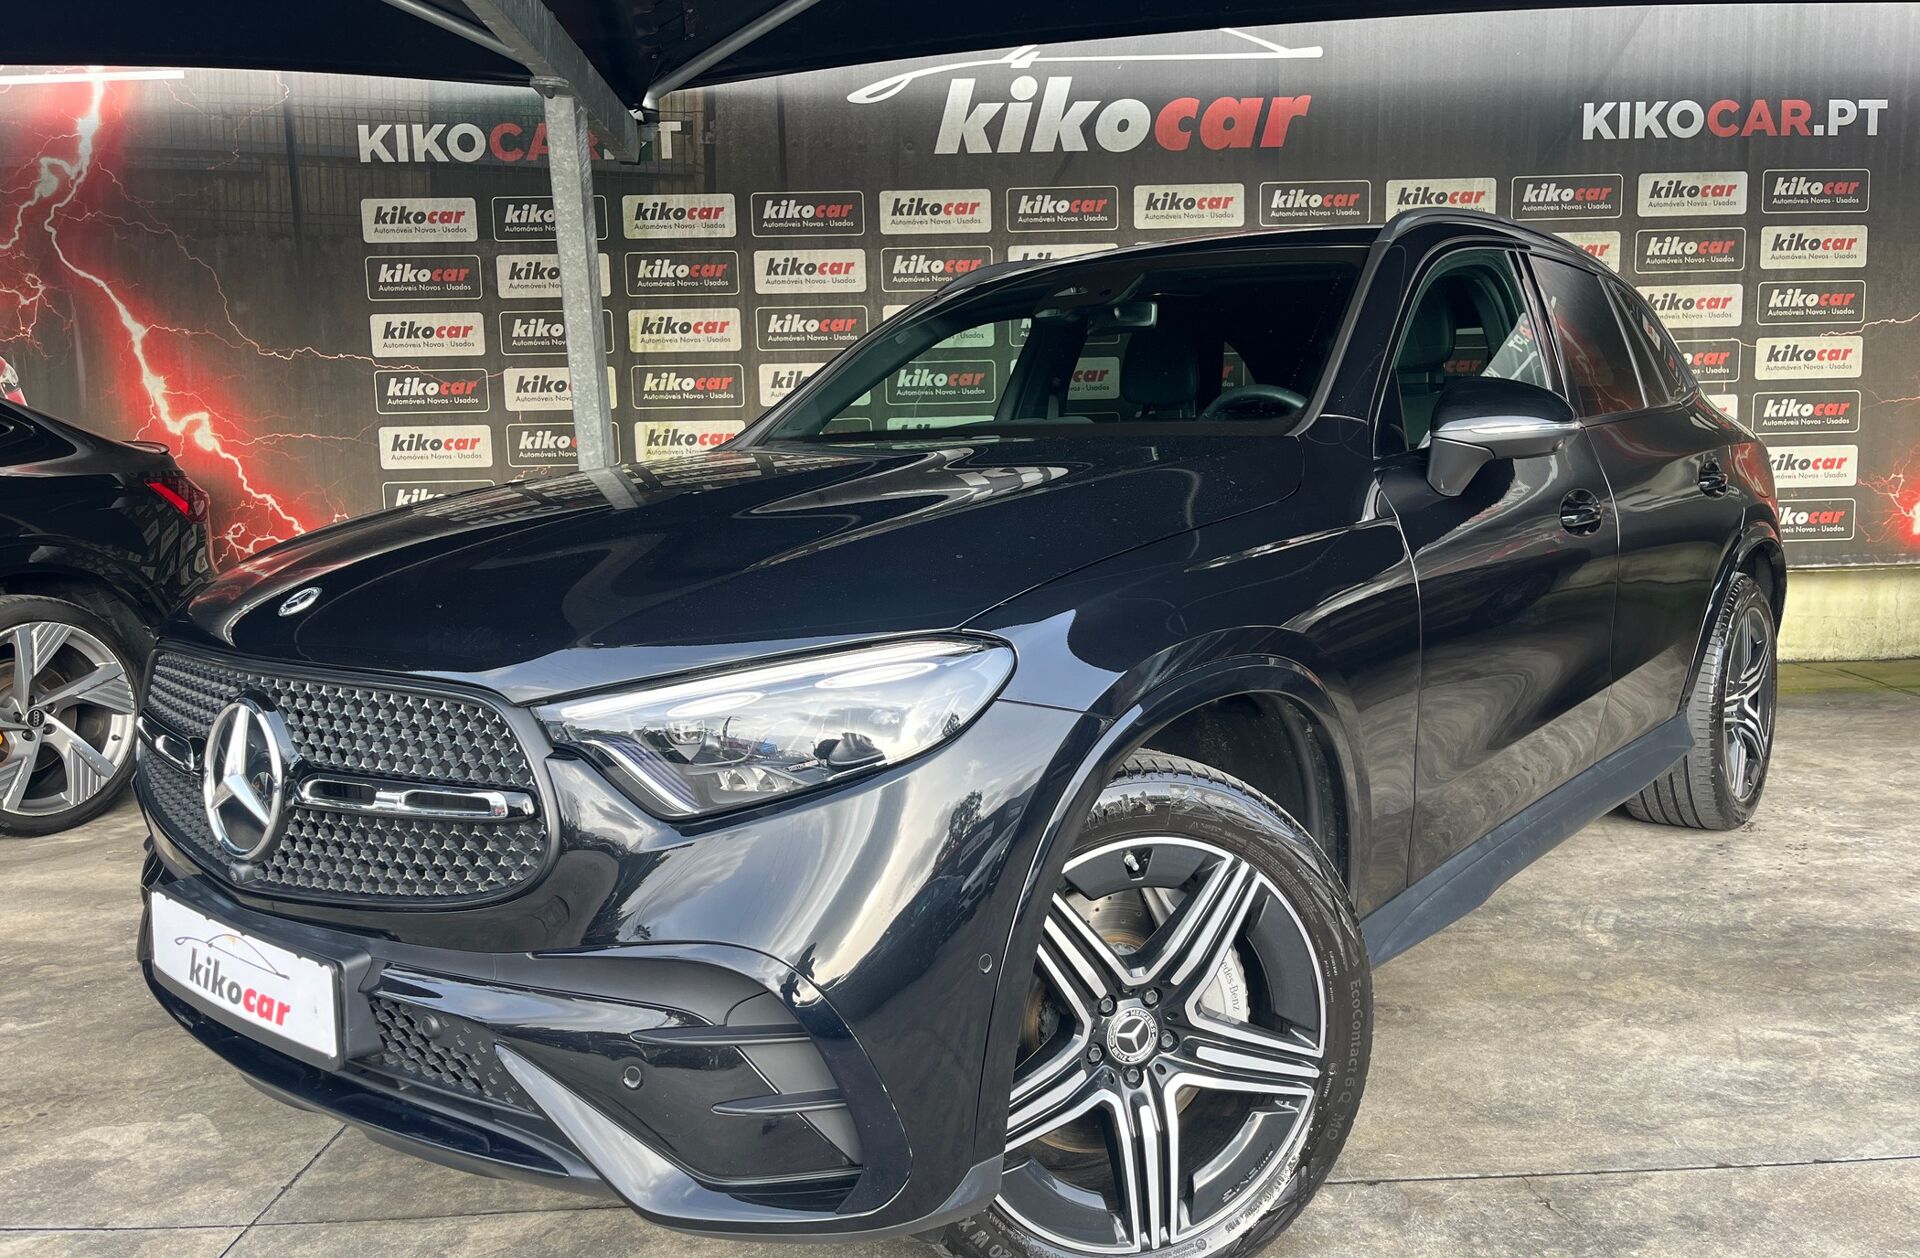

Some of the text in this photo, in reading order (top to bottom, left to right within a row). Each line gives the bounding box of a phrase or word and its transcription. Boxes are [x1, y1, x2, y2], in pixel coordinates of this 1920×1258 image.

[934, 75, 1311, 155] kikocar
[1583, 99, 1888, 140] KIKOCAR.PT
[1522, 183, 1611, 202] kikocar
[1648, 180, 1737, 198] kikocar
[1773, 176, 1859, 194] kikocar
[1018, 194, 1107, 213] kikocar
[1144, 192, 1233, 210] kikocar
[1270, 189, 1359, 207] kikocar
[1397, 187, 1485, 205] kikocar
[373, 206, 465, 224] kikocar
[504, 204, 555, 223] kiko
[634, 202, 724, 220] kikocar
[762, 199, 852, 218] kikocar
[890, 197, 980, 216] kikocar
[504, 225, 543, 233] Automóveis
[1646, 236, 1734, 255] kikocar
[1771, 233, 1857, 250] kikocar
[378, 263, 469, 282] kikocar
[509, 261, 560, 280] kiko
[637, 259, 727, 277] kikocar
[765, 257, 854, 275] kikocar
[893, 255, 982, 274] kikocar
[508, 282, 547, 290] Automóveis
[1648, 293, 1732, 311] kikocar
[1768, 288, 1855, 306] kikocar
[382, 321, 472, 339] kikocar
[512, 318, 564, 337] kiko
[640, 316, 729, 334] kikocar
[767, 314, 856, 332] kikocar
[512, 339, 550, 347] Automóveis
[1766, 344, 1852, 362] kikocar
[896, 368, 984, 386] kikocar
[1706, 366, 1729, 374] Usados
[387, 377, 476, 395] kikocar
[516, 375, 571, 393] kiko
[643, 372, 732, 390] kikocar
[1763, 398, 1850, 417] kikocar
[1762, 418, 1799, 426] Automóveis
[391, 433, 480, 451] kikocar
[188, 947, 291, 1026] kikocar
